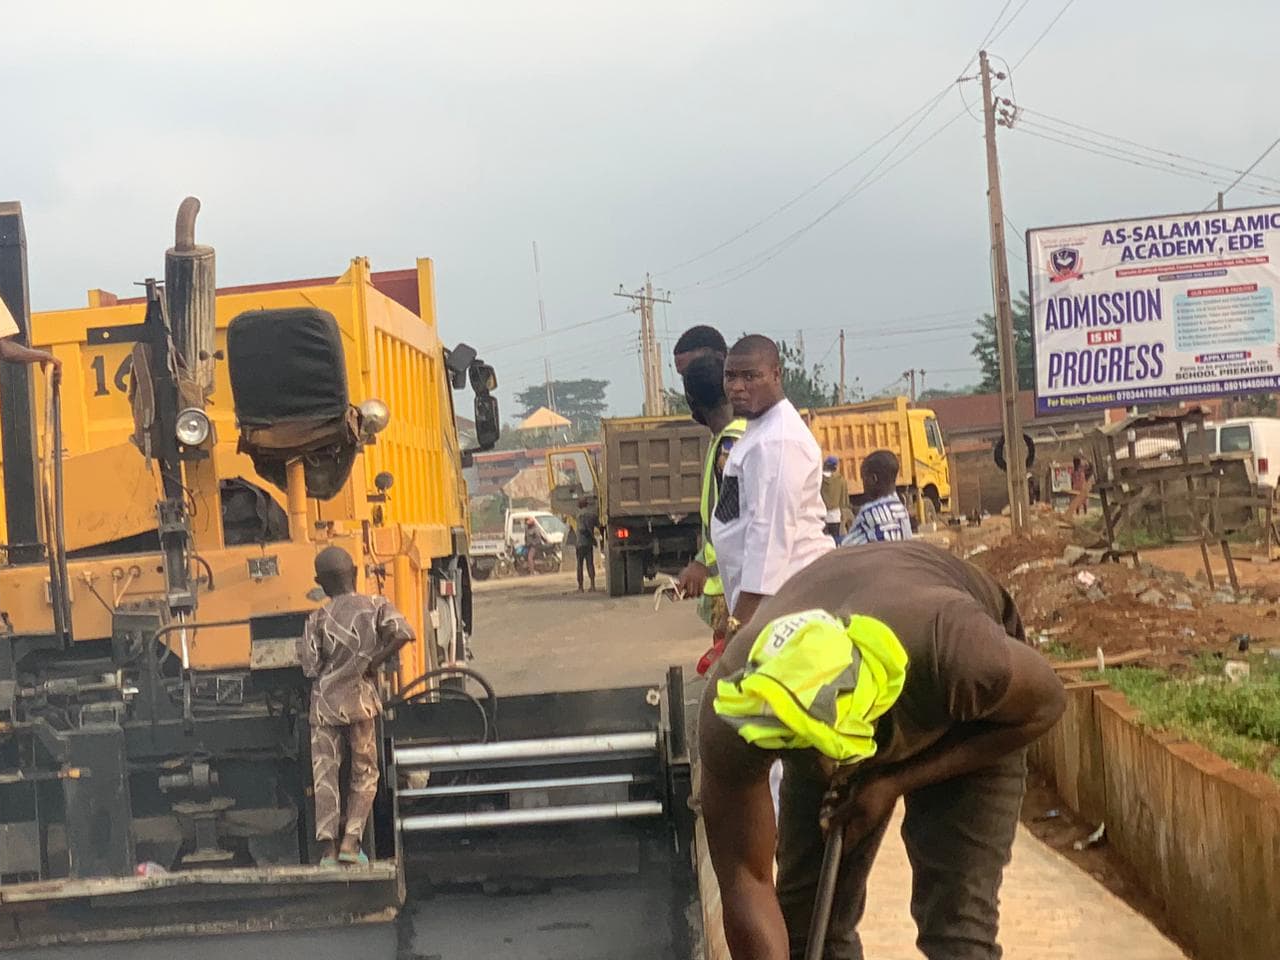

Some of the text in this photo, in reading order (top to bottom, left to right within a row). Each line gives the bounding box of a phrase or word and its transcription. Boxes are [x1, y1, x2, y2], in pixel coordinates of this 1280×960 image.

[1101, 221, 1200, 245] AS-SALAM
[1206, 213, 1280, 235] ISLAMIC
[1228, 233, 1264, 251] EDE
[1045, 288, 1162, 332] ADMISSION
[1090, 331, 1118, 344] IS IN
[1047, 343, 1165, 389] PROGRESS
[1203, 354, 1226, 363] APPLY
[1175, 365, 1274, 380] SCHOOL PREMISES
[1047, 398, 1059, 407] For
